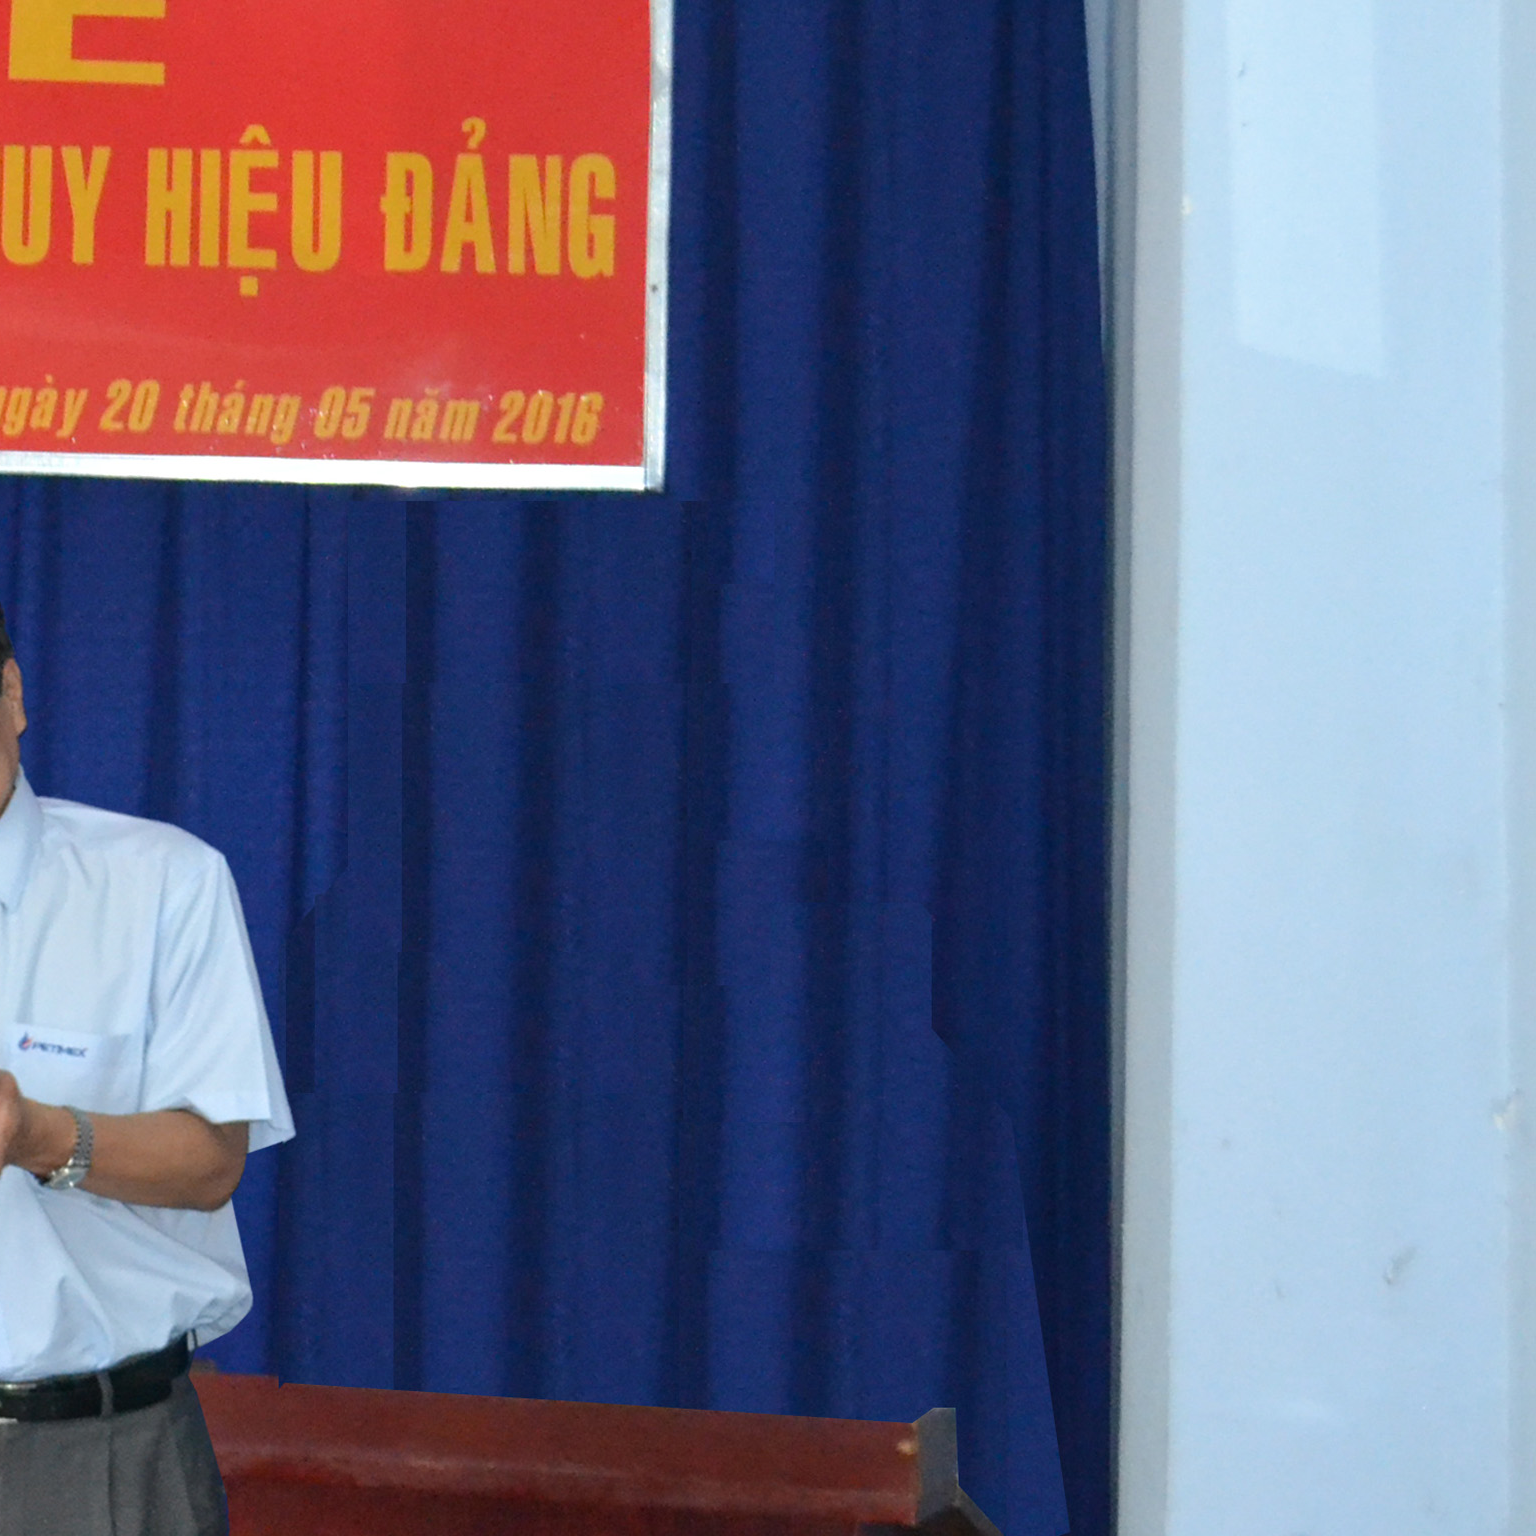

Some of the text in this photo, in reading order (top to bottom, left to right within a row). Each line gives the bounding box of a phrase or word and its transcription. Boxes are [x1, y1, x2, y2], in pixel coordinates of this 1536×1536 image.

[143, 123, 344, 298] HIỆU
[378, 117, 619, 281] ĐẢNG
[99, 379, 162, 434] 20
[173, 382, 302, 447] tháng
[314, 386, 375, 442] 05
[384, 390, 482, 443] năm
[493, 390, 606, 447] 2016
